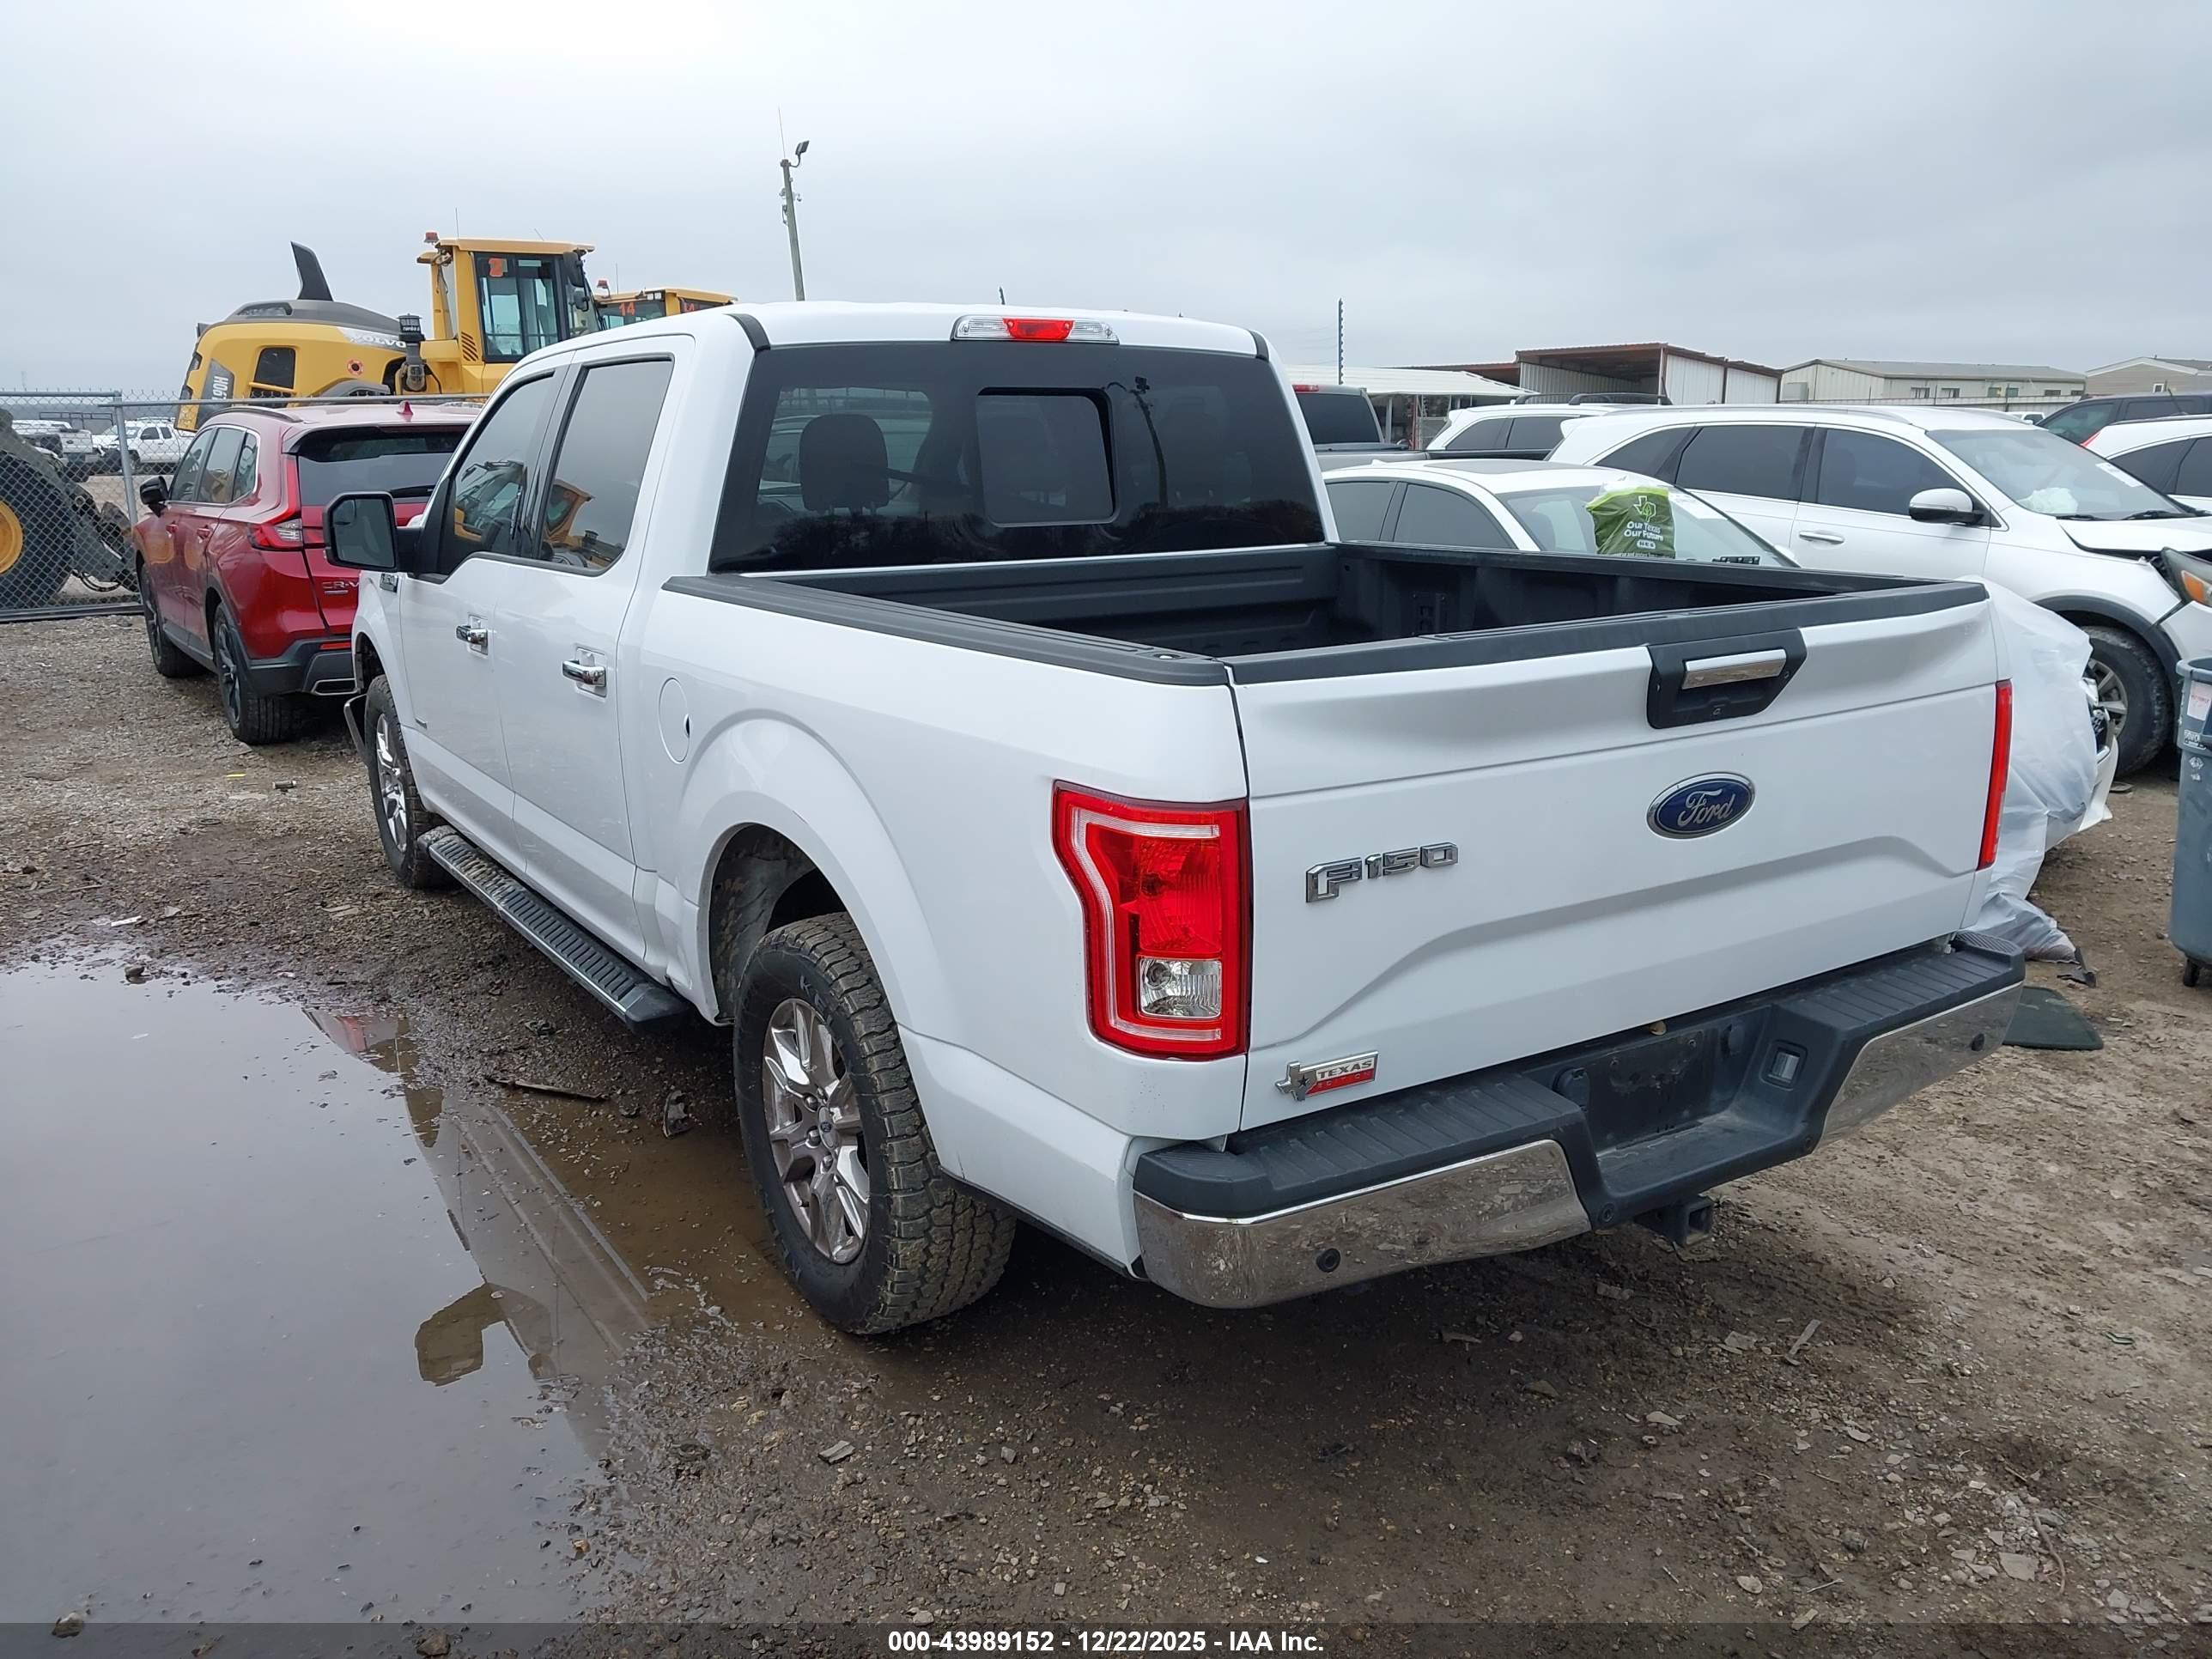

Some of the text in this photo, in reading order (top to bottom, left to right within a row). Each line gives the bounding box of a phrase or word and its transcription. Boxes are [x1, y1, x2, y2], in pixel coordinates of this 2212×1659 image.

[1627, 520, 1644, 529] Our
[1624, 529, 1643, 538] Our
[1677, 788, 1736, 827] Ford
[1317, 1060, 1373, 1079] TEXAS
